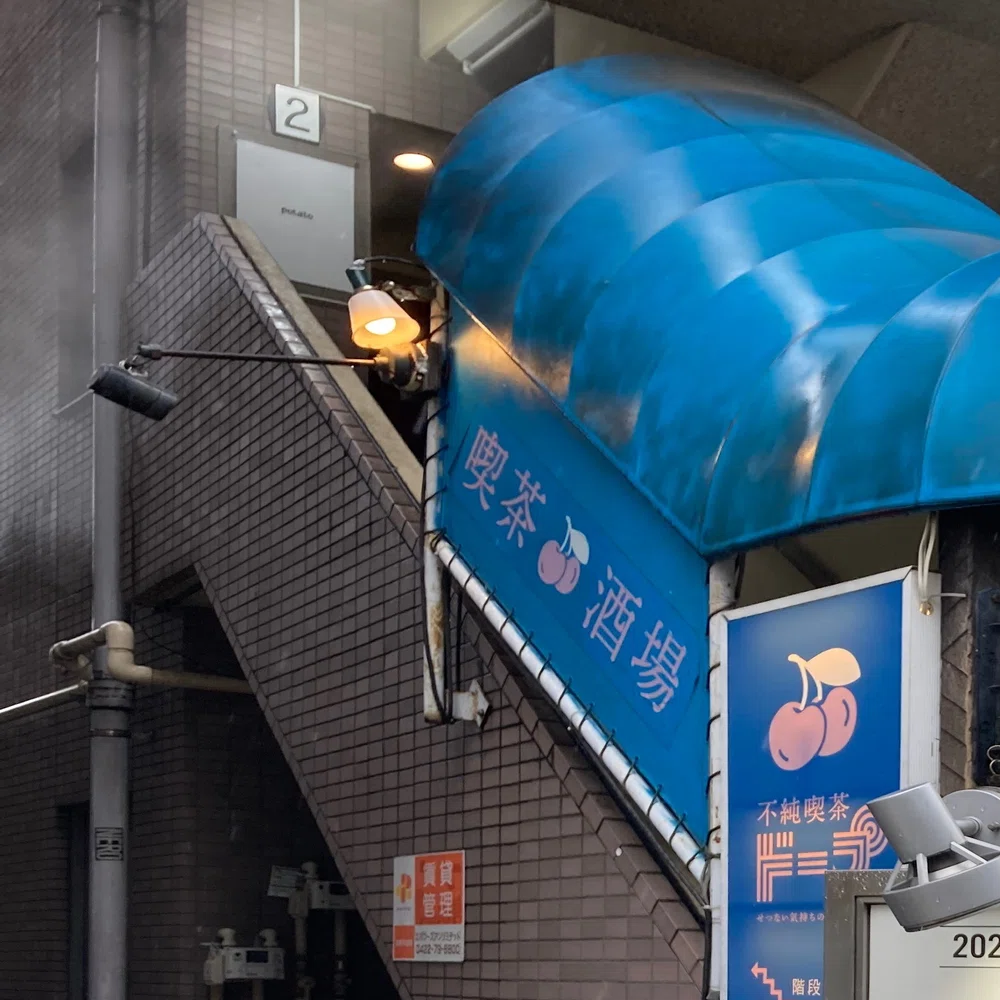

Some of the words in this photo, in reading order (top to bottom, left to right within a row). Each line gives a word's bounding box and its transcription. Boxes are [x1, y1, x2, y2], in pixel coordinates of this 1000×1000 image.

[284, 97, 310, 133] 2
[462, 425, 547, 549] 喫茶
[582, 565, 688, 713] 酒場
[756, 792, 850, 827] 不純喫茶
[792, 978, 821, 996] 階段
